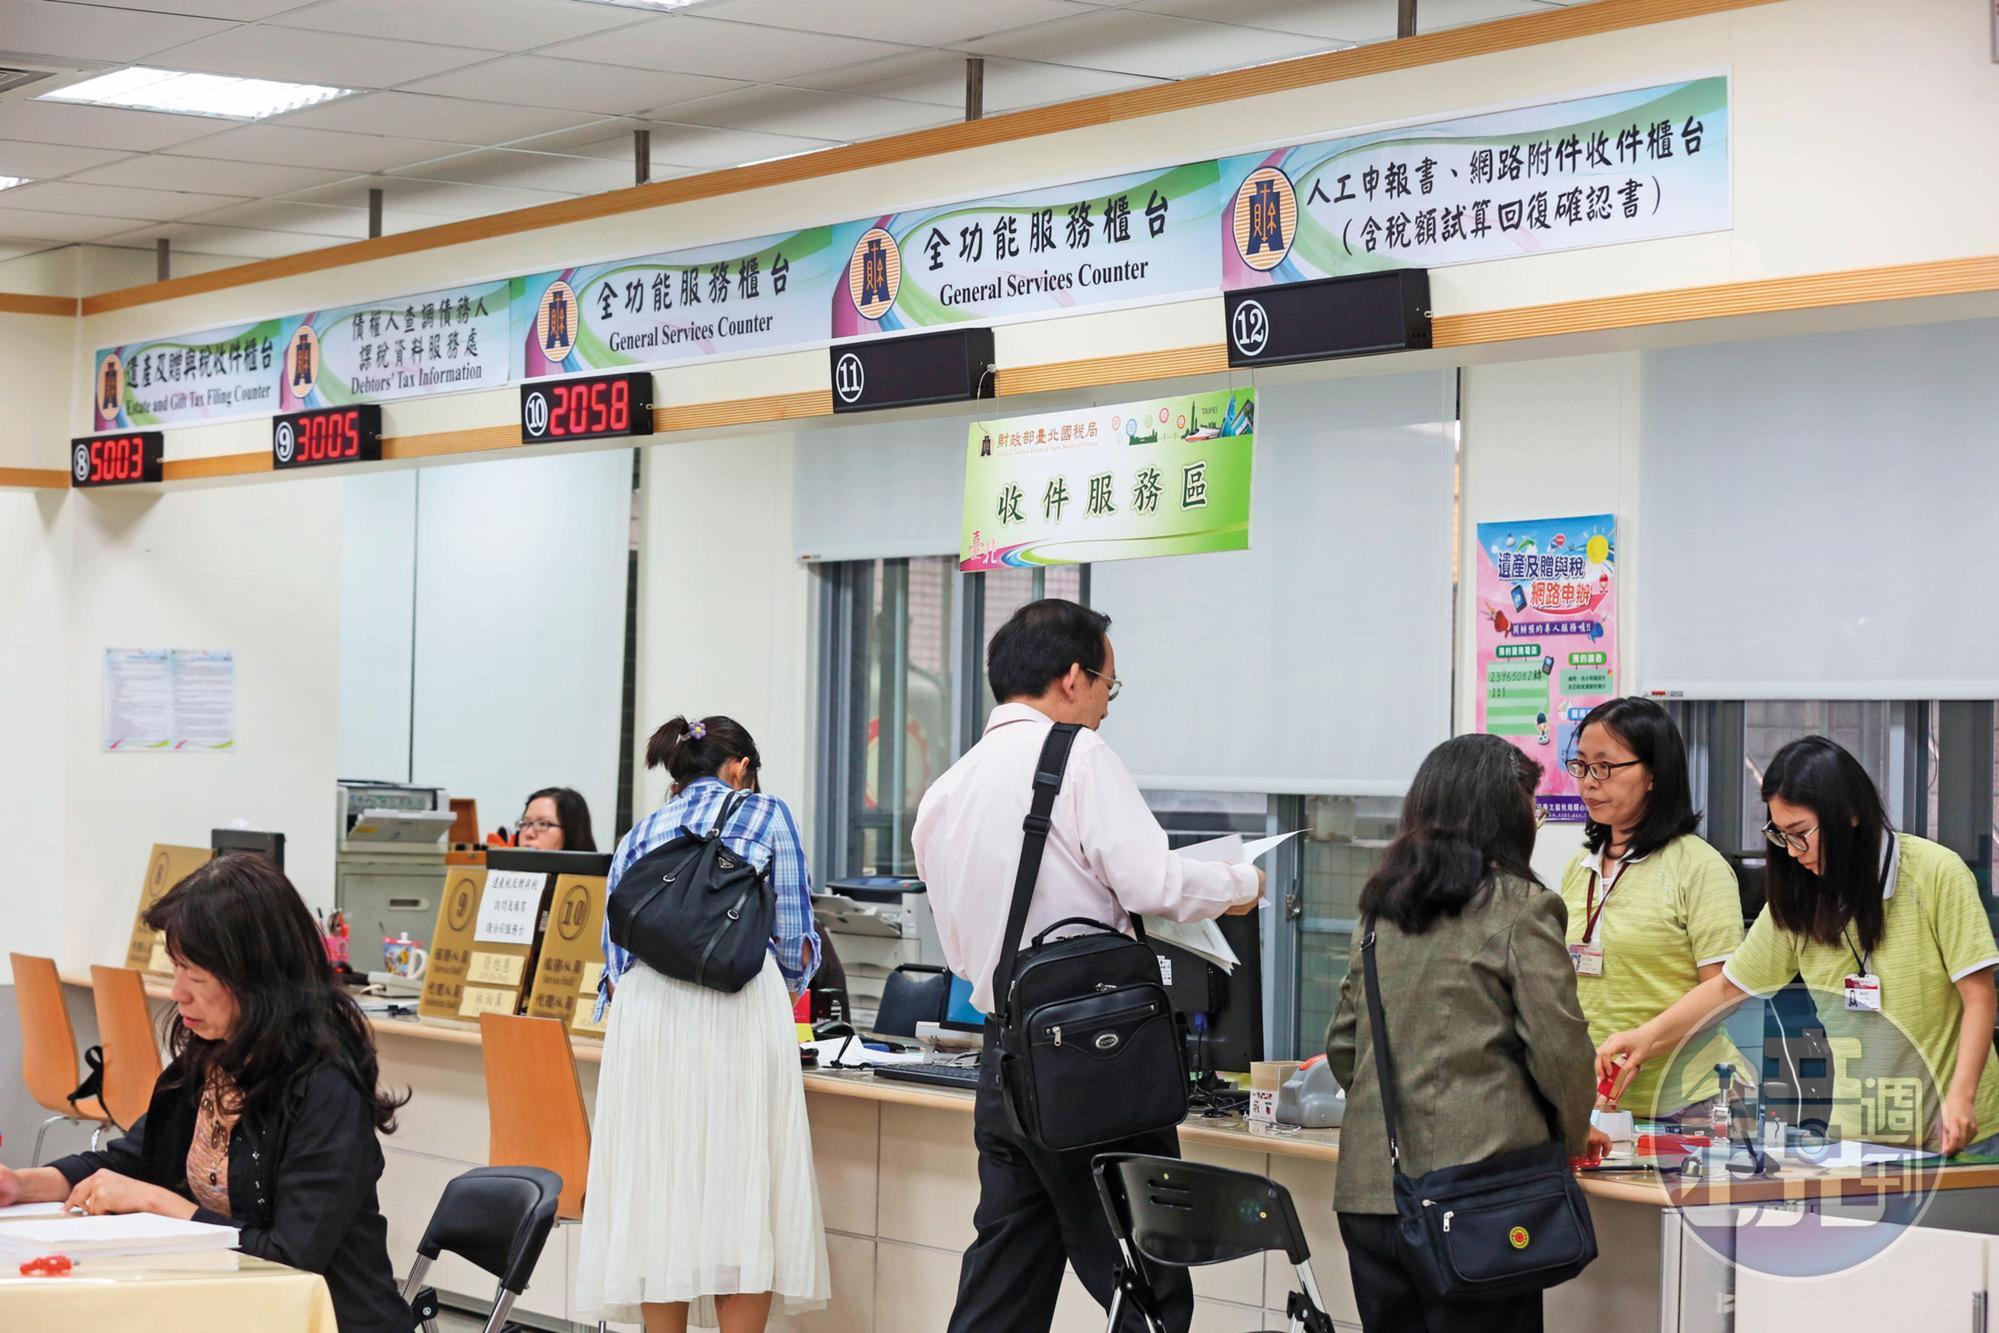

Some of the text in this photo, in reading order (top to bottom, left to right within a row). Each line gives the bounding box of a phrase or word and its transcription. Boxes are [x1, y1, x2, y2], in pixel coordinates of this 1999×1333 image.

[1307, 114, 1705, 207] 人工申報書、網路附件收件櫃台
[923, 188, 1169, 272] 全功能服務櫃台
[1343, 176, 1662, 256] (含稅額試算回復確認書)
[596, 251, 790, 320] 全功能服務櫃台
[939, 259, 1149, 306] General Services Counter
[609, 312, 773, 352] General Services Counter
[1237, 308, 1265, 347] 12
[153, 395, 168, 412] and
[170, 392, 187, 410] Gift
[189, 390, 205, 408] Tax
[207, 388, 232, 408] Filing
[234, 385, 271, 402] Counter
[351, 362, 482, 395] Debtors' Tax Information
[550, 379, 629, 436] 2058
[297, 410, 359, 461] 3005
[997, 422, 1098, 448] 財政部臺北國稅局
[91, 437, 143, 481] 5003
[997, 461, 1207, 525] 收件服務區
[1499, 552, 1585, 579] 遺產及贈與稅
[1531, 581, 1592, 606] 網路申辦
[561, 899, 587, 927] 10
